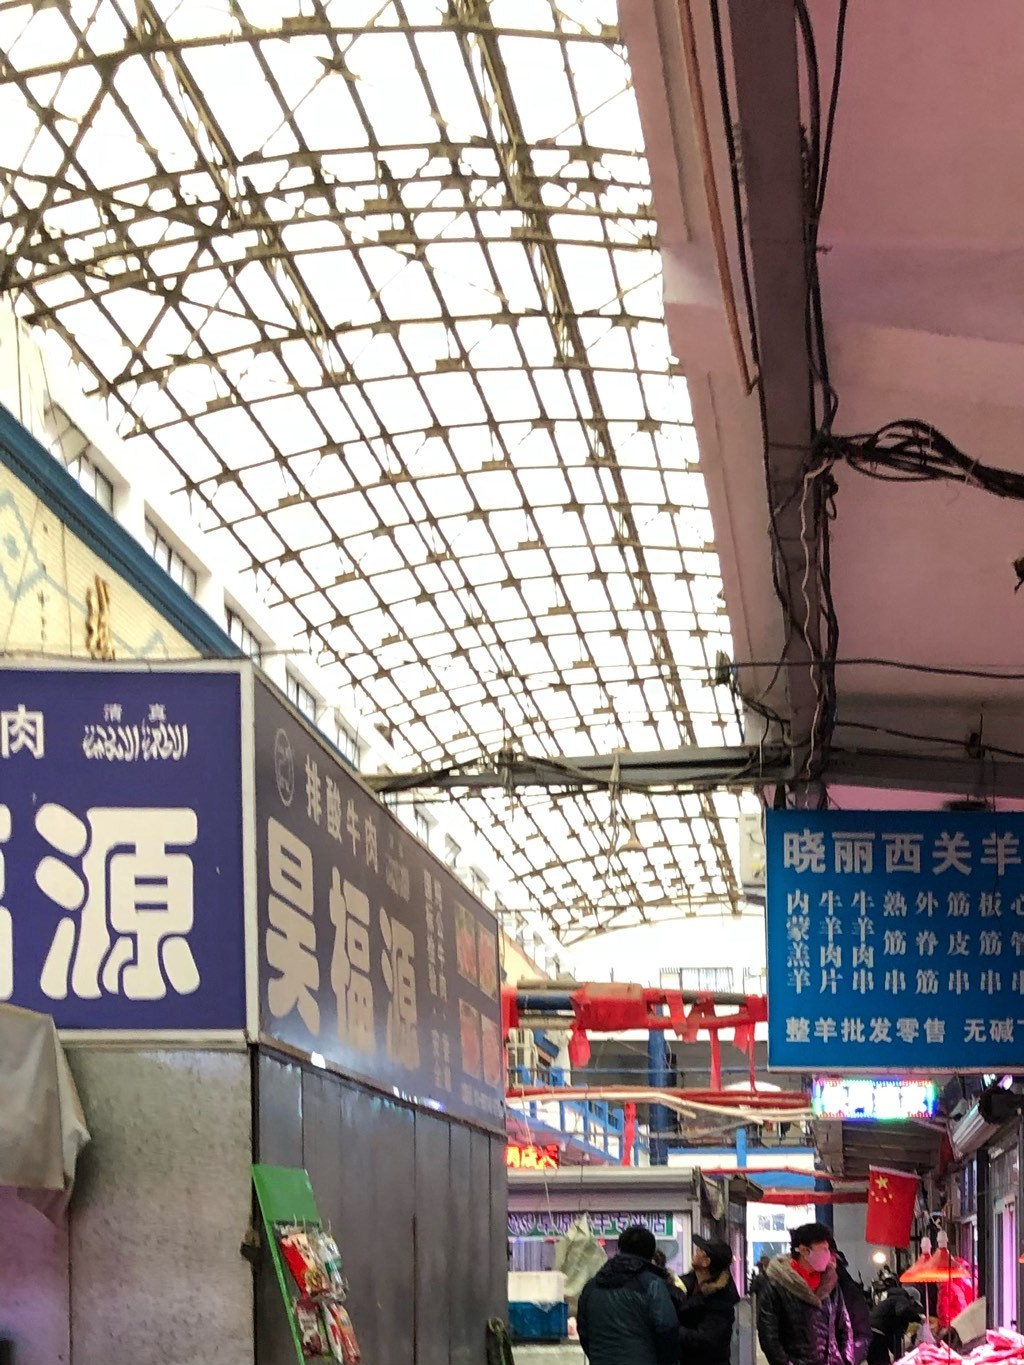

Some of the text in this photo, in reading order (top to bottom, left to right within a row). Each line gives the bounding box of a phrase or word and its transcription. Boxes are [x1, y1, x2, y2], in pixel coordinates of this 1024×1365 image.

[305, 754, 378, 873] 排酸牛肉
[0, 803, 200, 1000] 源
[819, 890, 843, 994] 牛羊肉片
[851, 890, 875, 995] 牛羊肉串
[883, 890, 907, 995] 熟筋串
[915, 891, 939, 995] 外脊筋
[947, 891, 971, 995] 筋皮串
[979, 891, 1003, 995] 板筋串
[785, 1016, 946, 1044] 整羊批发零售
